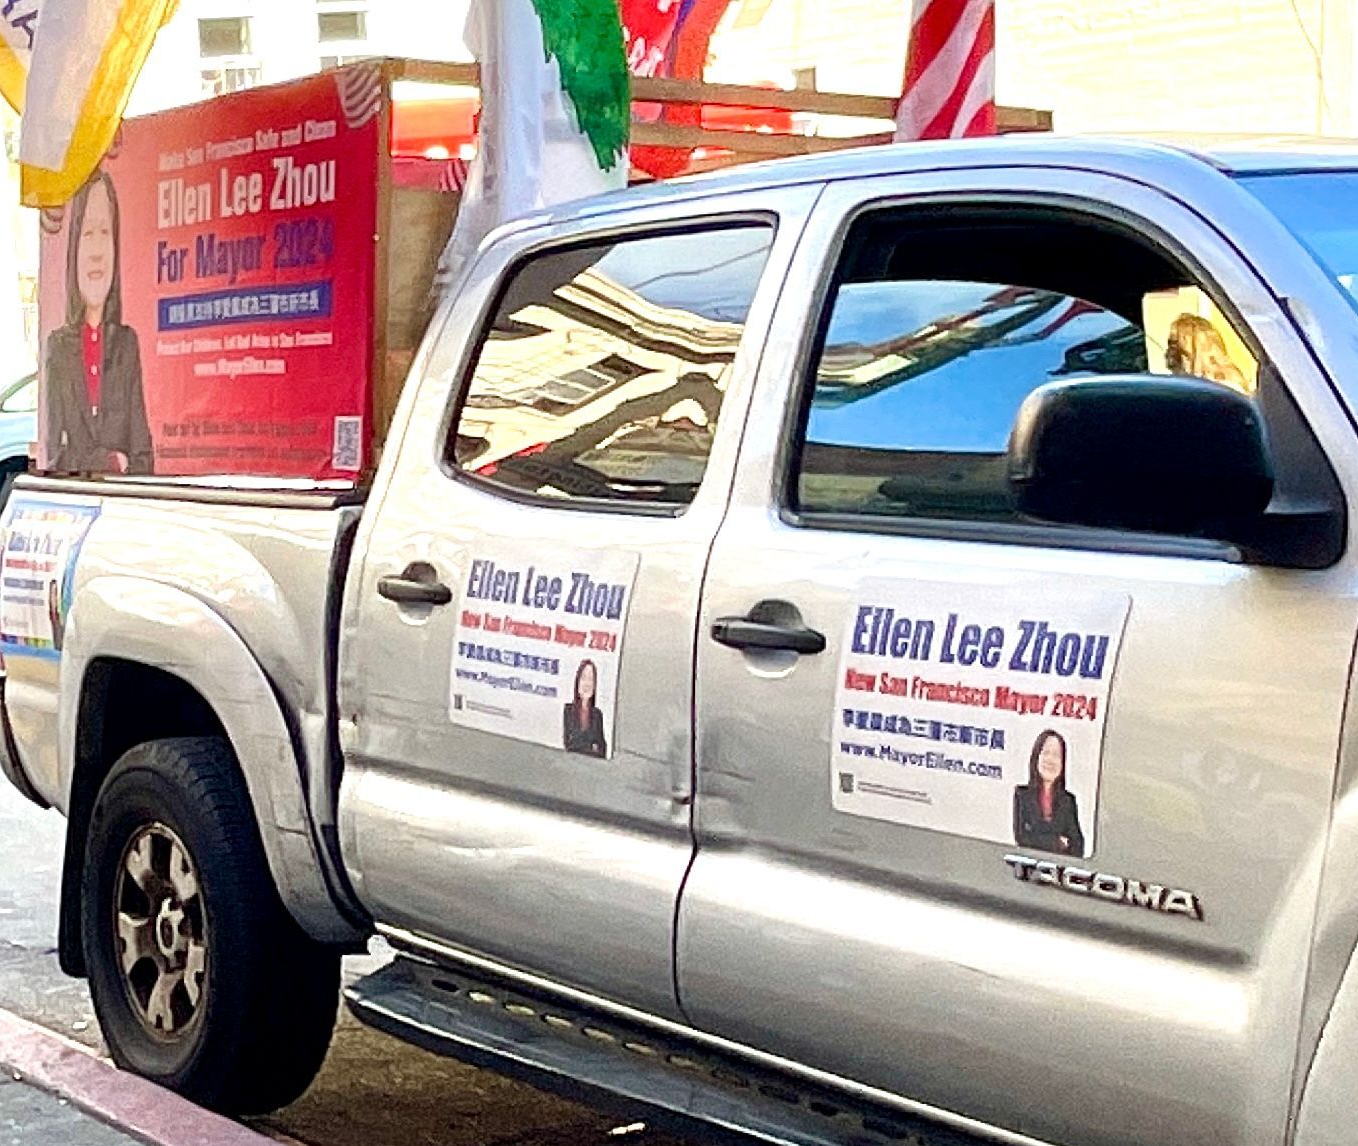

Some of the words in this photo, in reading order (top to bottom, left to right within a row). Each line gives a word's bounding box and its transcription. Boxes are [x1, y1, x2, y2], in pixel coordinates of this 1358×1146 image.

[157, 178, 213, 230] Ellen
[219, 167, 264, 218] Lee
[269, 156, 337, 211] Zhou
[157, 240, 189, 284] For
[195, 233, 267, 284] Mayor
[467, 558, 521, 605] Ellen
[521, 566, 564, 612] Lee
[564, 572, 628, 621] Zhou
[850, 604, 936, 662] Ellen
[938, 613, 1006, 670] Lee
[1008, 619, 1111, 681] Zhou
[844, 667, 878, 694] New
[878, 672, 908, 698] San
[910, 676, 991, 709] Francisco
[993, 685, 1049, 716] Mayor
[1050, 692, 1099, 722] 2024
[1003, 854, 1205, 922] TACOMA
